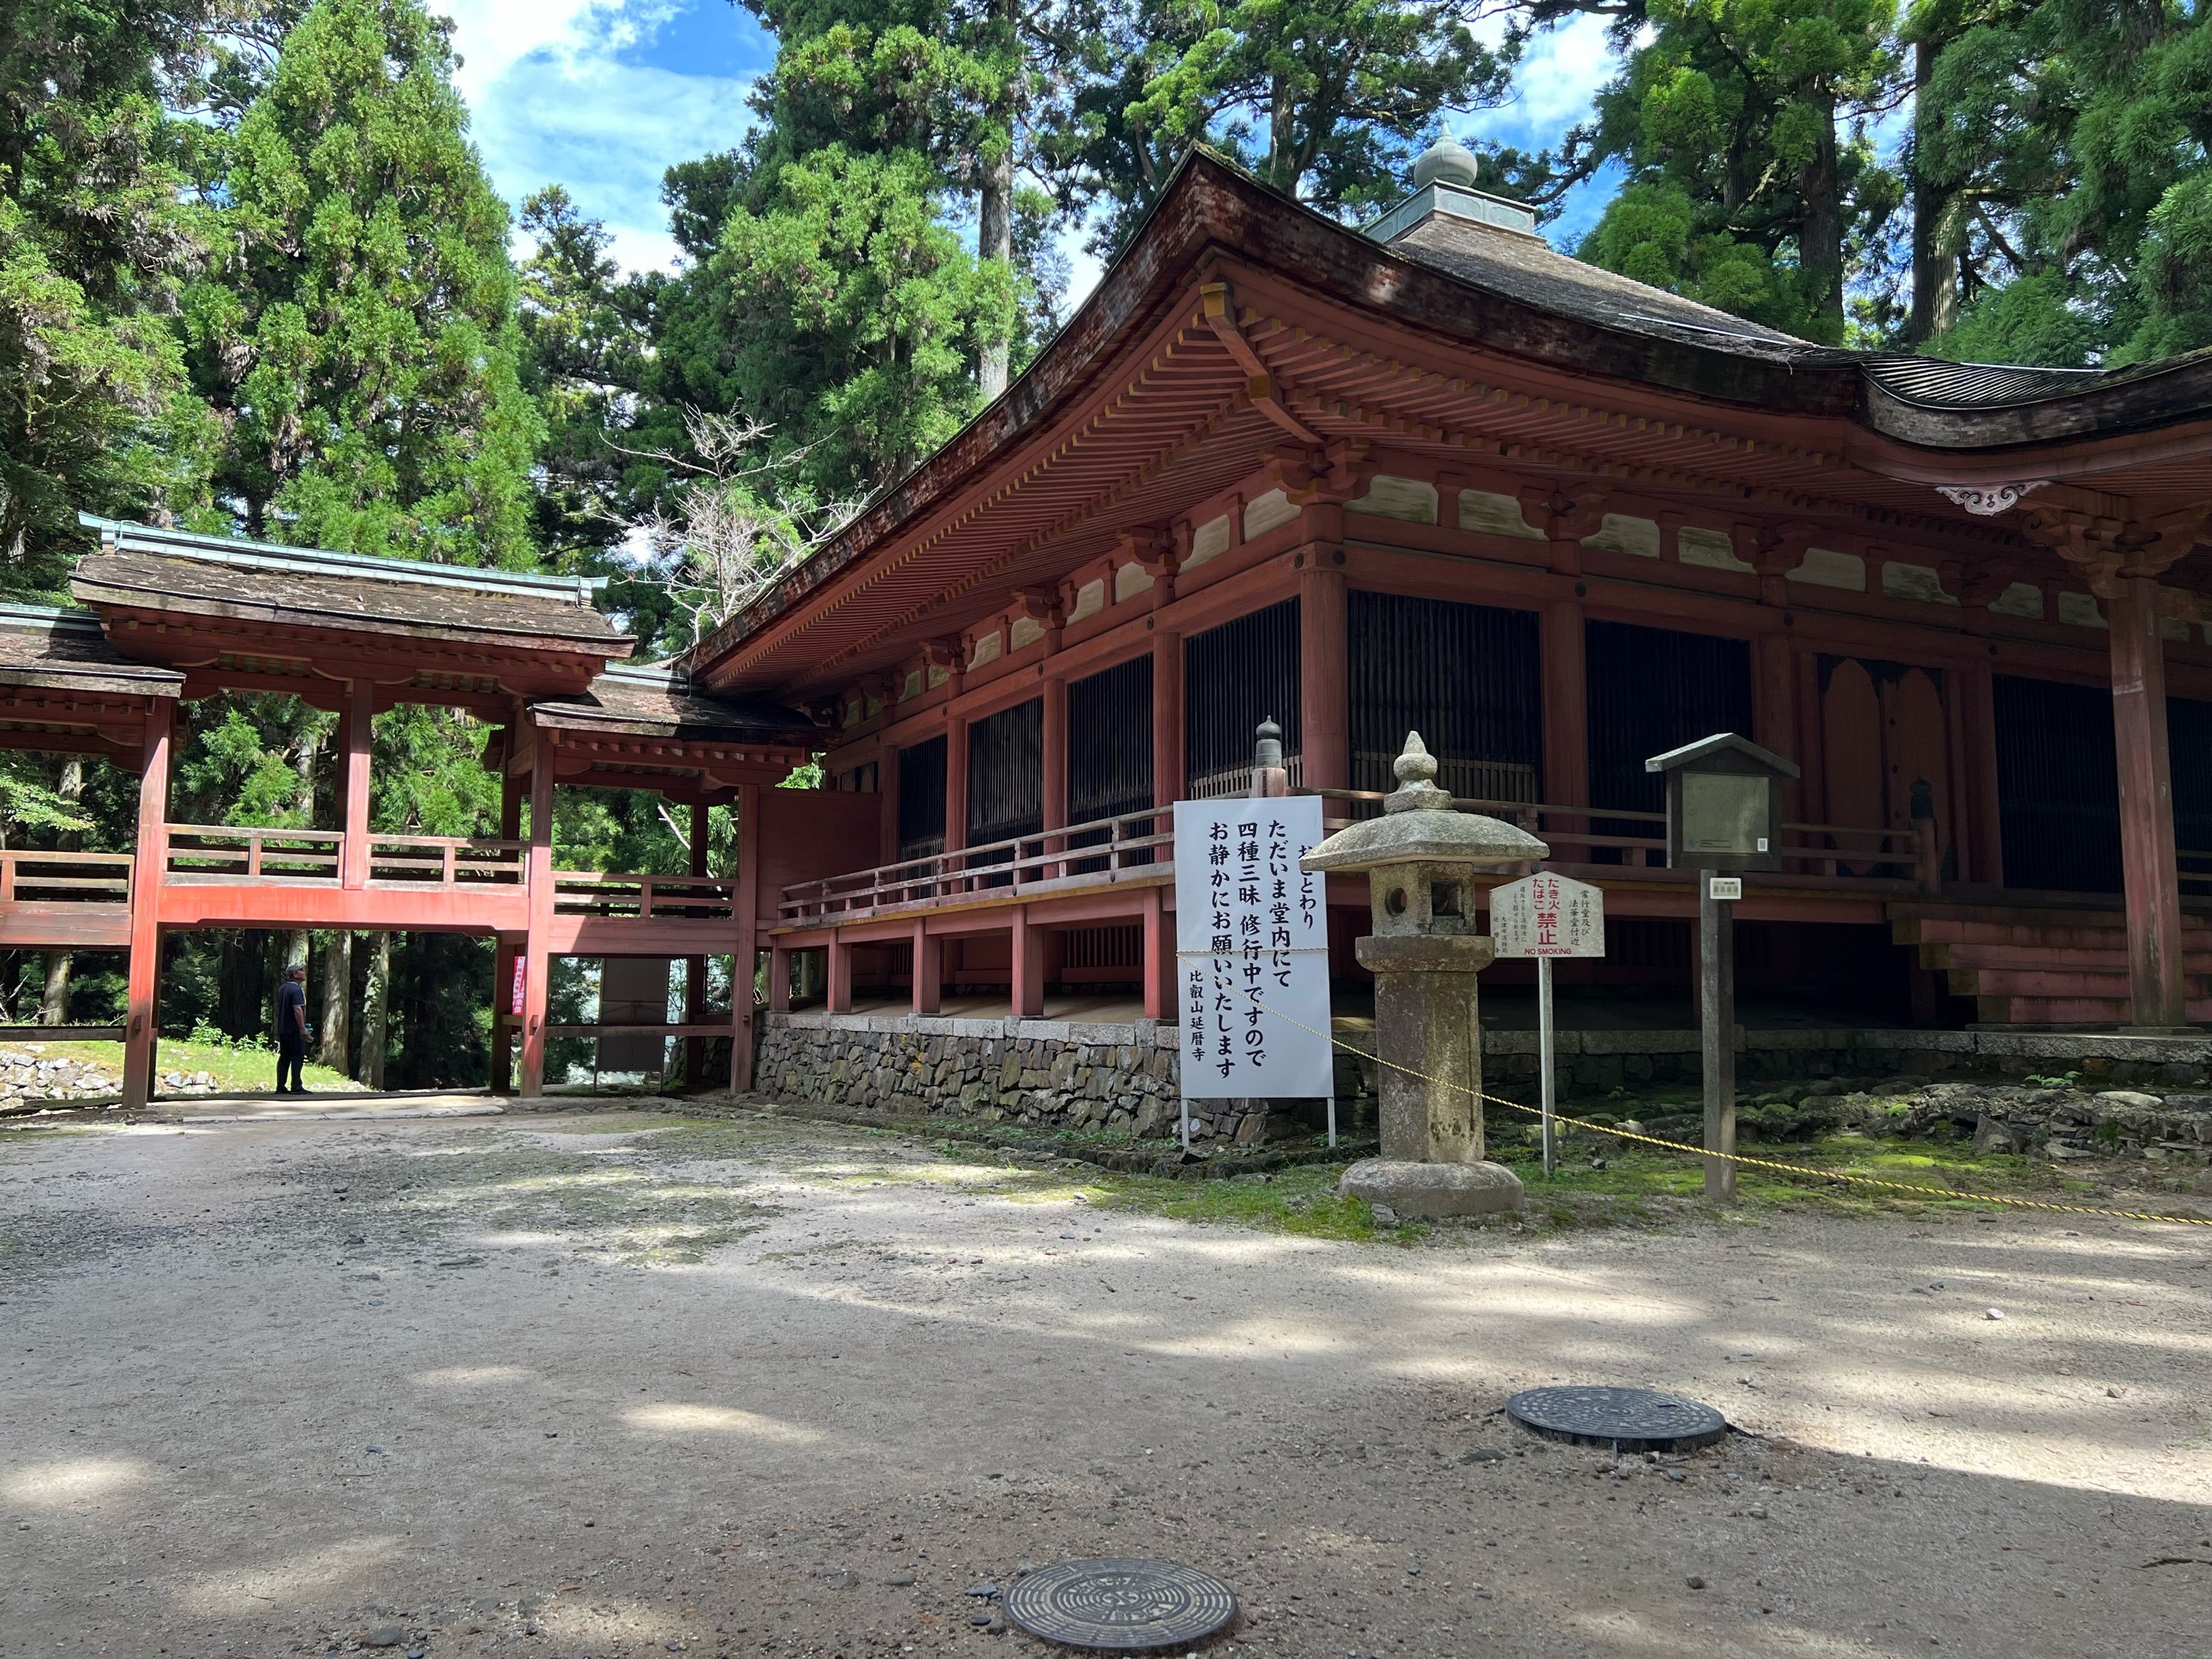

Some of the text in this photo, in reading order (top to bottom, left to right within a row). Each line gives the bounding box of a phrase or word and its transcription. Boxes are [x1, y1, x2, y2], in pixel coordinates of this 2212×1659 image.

[1268, 820, 1292, 987] ただいま堂内にて
[1533, 878, 1544, 910] たばこ
[1548, 878, 1560, 910] たき火
[1581, 890, 1591, 936] 常行堂及び
[1537, 913, 1557, 945] 禁止
[1569, 900, 1579, 945] 法華堂付近
[1208, 821, 1236, 1079] お静かにお願いいたします
[1189, 970, 1206, 1062] 比叡山延暦寺
